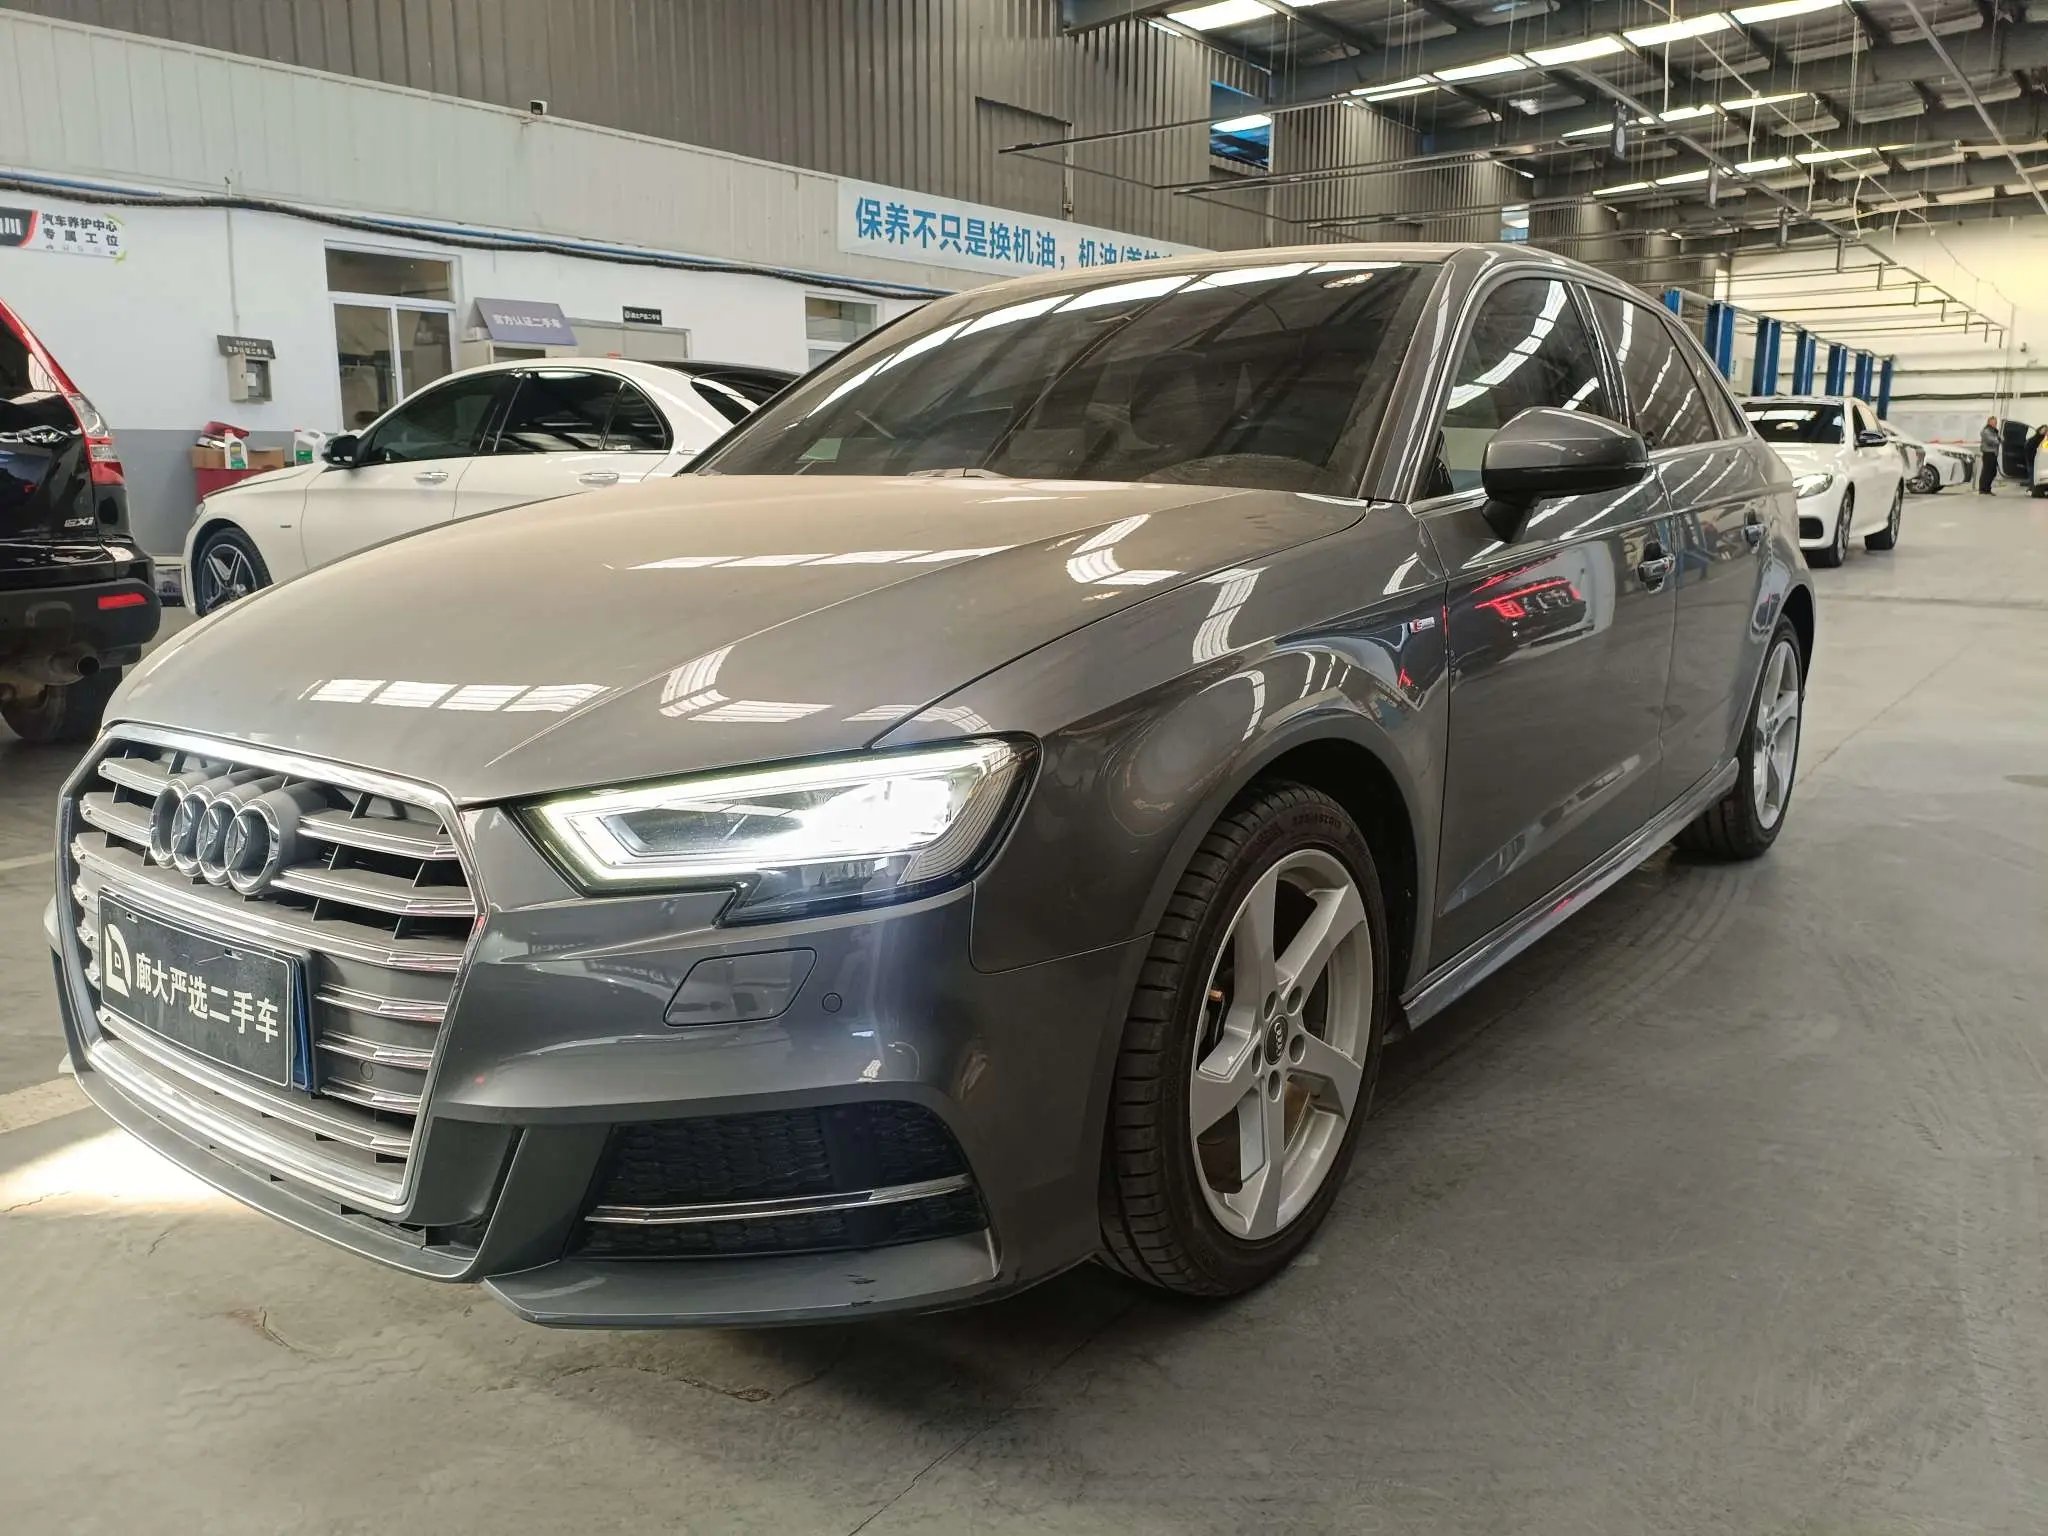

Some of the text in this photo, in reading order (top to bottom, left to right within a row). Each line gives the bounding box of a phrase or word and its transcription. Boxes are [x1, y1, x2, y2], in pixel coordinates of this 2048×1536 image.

[42, 213, 118, 232] 汽车养护中心
[43, 228, 119, 247] 专属工位
[135, 952, 279, 1042] 廊大严选二手车
